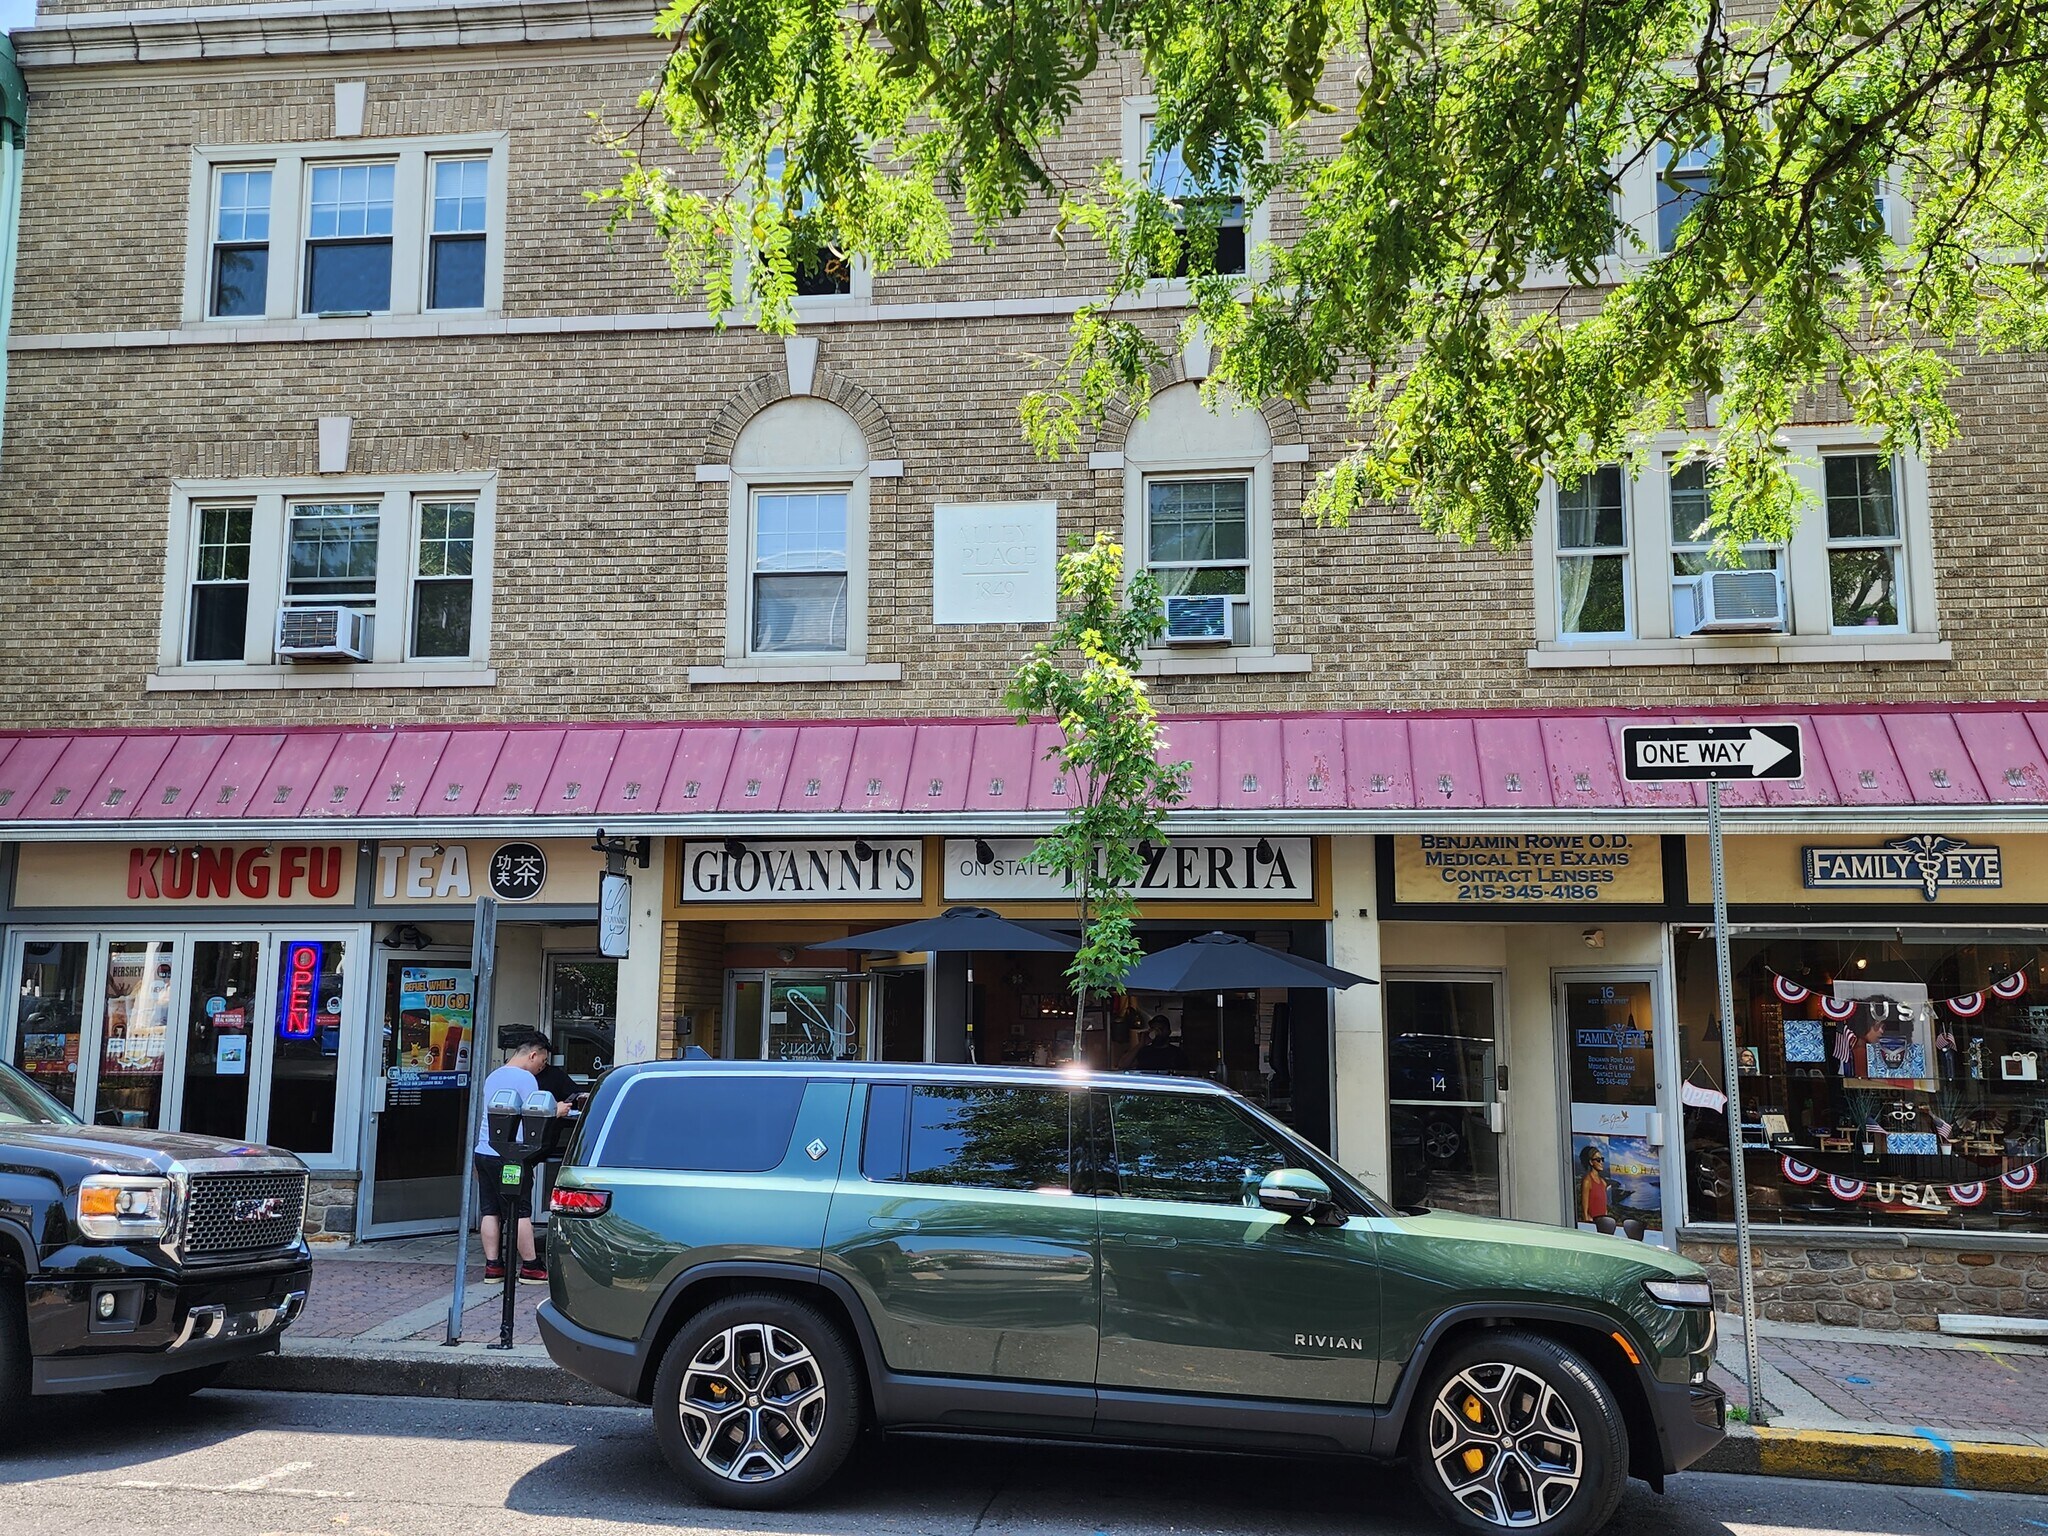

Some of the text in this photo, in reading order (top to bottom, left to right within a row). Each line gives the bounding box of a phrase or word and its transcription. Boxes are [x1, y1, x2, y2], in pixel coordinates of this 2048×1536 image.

[955, 524, 1032, 545] ALLEY
[962, 546, 1039, 567] PLACE
[1643, 742, 1746, 764] ONE WAY
[1420, 834, 1632, 849] BENJAMIN ROWE O.D.
[1061, 844, 1297, 890] IZERIA
[1425, 851, 1629, 866] MEDICAL EYE EXAMS
[1812, 849, 2000, 879] FAMILY EYE
[127, 847, 342, 899] KUNG FU
[379, 845, 471, 898] TEA
[692, 847, 915, 893] GIOVANNI'S
[960, 859, 1049, 877] ON STATE
[1441, 868, 1614, 883] CONTACT LENSES
[1458, 885, 1598, 900] 215-345-4186
[112, 966, 145, 978] HERSHEY'
[288, 947, 316, 1033] OPEN
[404, 978, 456, 992] REFUEL WHILE
[1600, 986, 1615, 999] 16
[425, 993, 446, 1008] YOU
[1578, 1030, 1645, 1045] FAMILY EYE
[593, 1056, 602, 1070] 8
[1431, 1077, 1446, 1092] 14
[1683, 1087, 1721, 1106] OPEN
[1615, 1164, 1656, 1176] ALOHA
[1875, 1182, 1942, 1206] USA
[1294, 1333, 1363, 1350] RIVIAN
